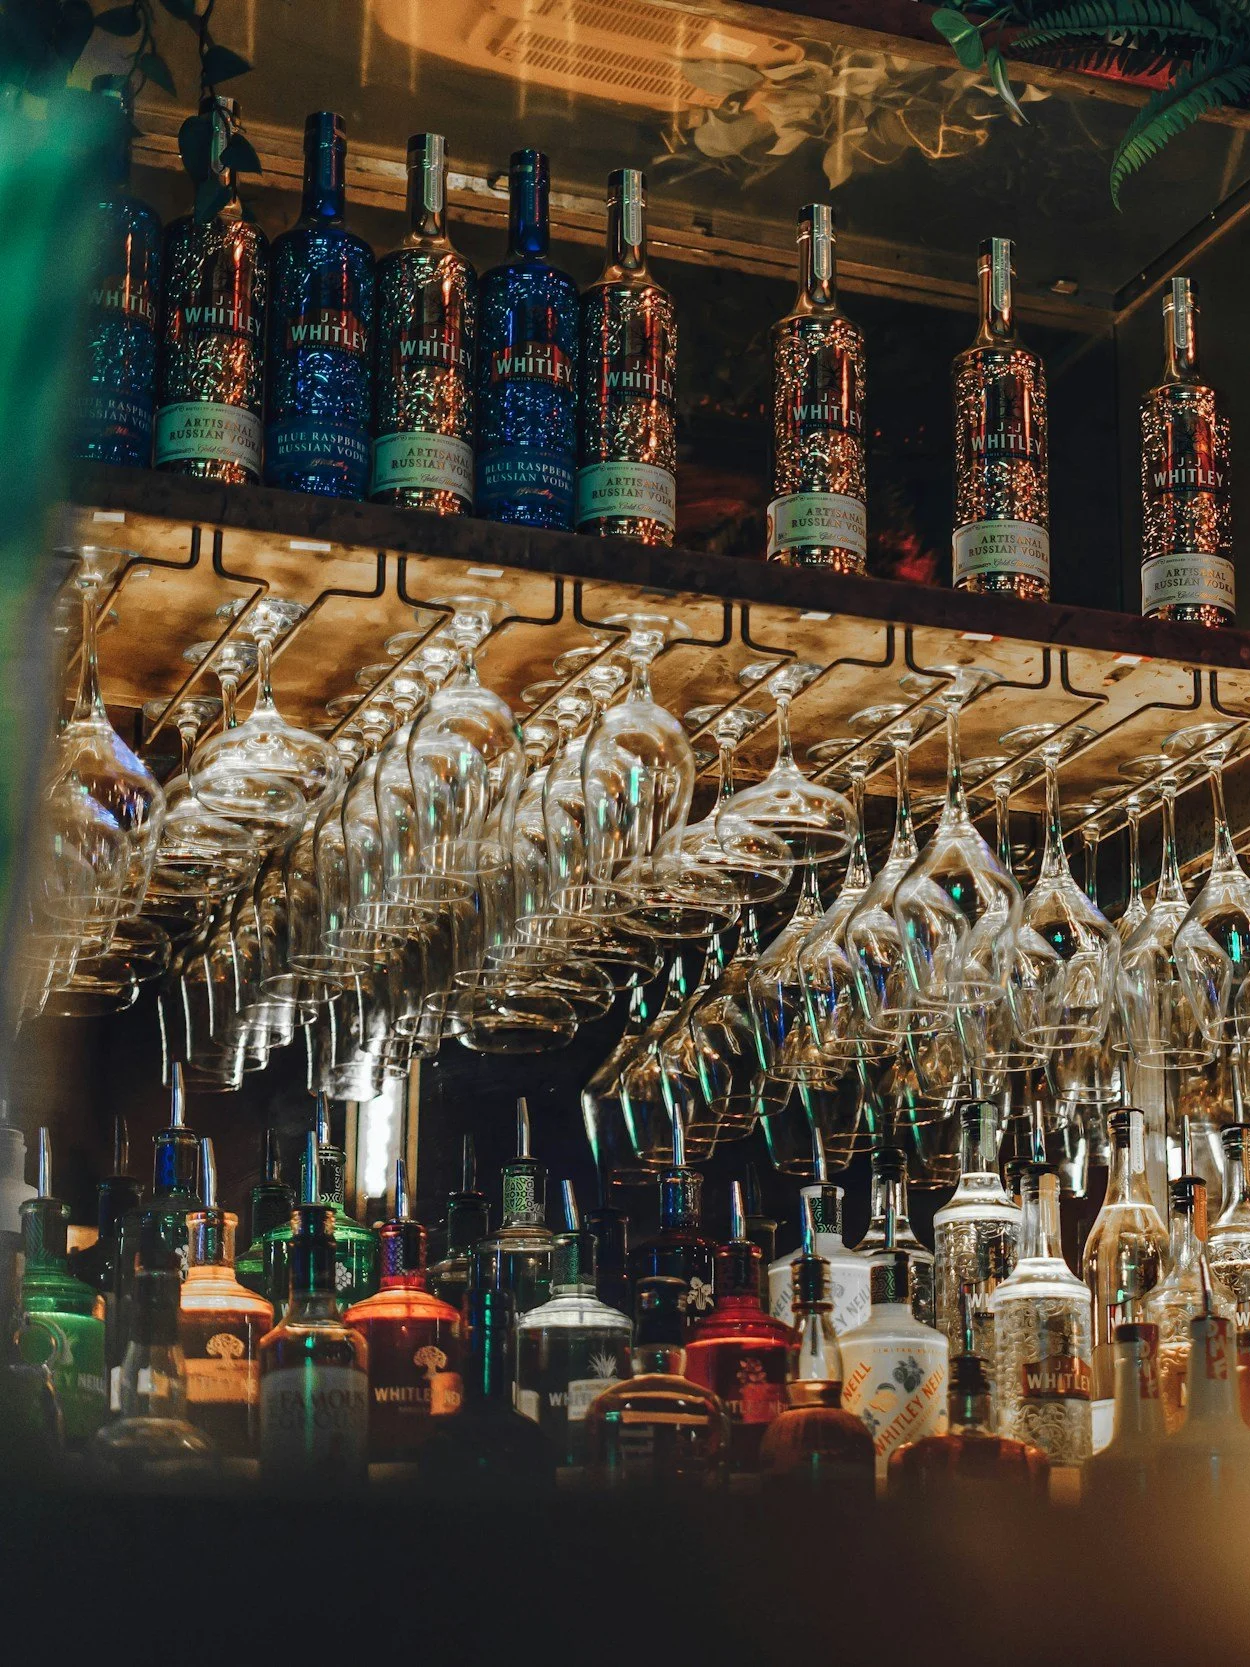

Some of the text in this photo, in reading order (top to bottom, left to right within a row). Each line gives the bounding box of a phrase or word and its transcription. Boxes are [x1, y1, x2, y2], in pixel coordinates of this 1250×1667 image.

[185, 306, 261, 336] WHITLEY
[291, 324, 368, 352] WHITLEY
[400, 340, 472, 369] WHITLEY
[496, 357, 572, 382] WHITLEY
[604, 372, 674, 398] WHITLEY
[169, 428, 223, 441] RUSSIAN
[185, 418, 253, 438] ARTISANAL
[278, 442, 332, 455] RUSSIAN
[971, 434, 1041, 455] WHITLEY
[391, 459, 445, 470] RUSSIAN
[407, 447, 469, 468] ARTISANAL
[486, 472, 536, 485] RUSSIAN
[606, 478, 669, 494] ARTISANAL
[1153, 468, 1224, 488] WHITLEY
[591, 488, 643, 499] RUSSIAN
[792, 518, 842, 529] RUSSIAN
[981, 534, 1042, 549] ARTISANAL
[969, 545, 1016, 558] RUSSIAN
[1166, 568, 1226, 580] ARTISANAL
[1155, 578, 1199, 591] RUSSIAN
[842, 1362, 872, 1401] NEILL
